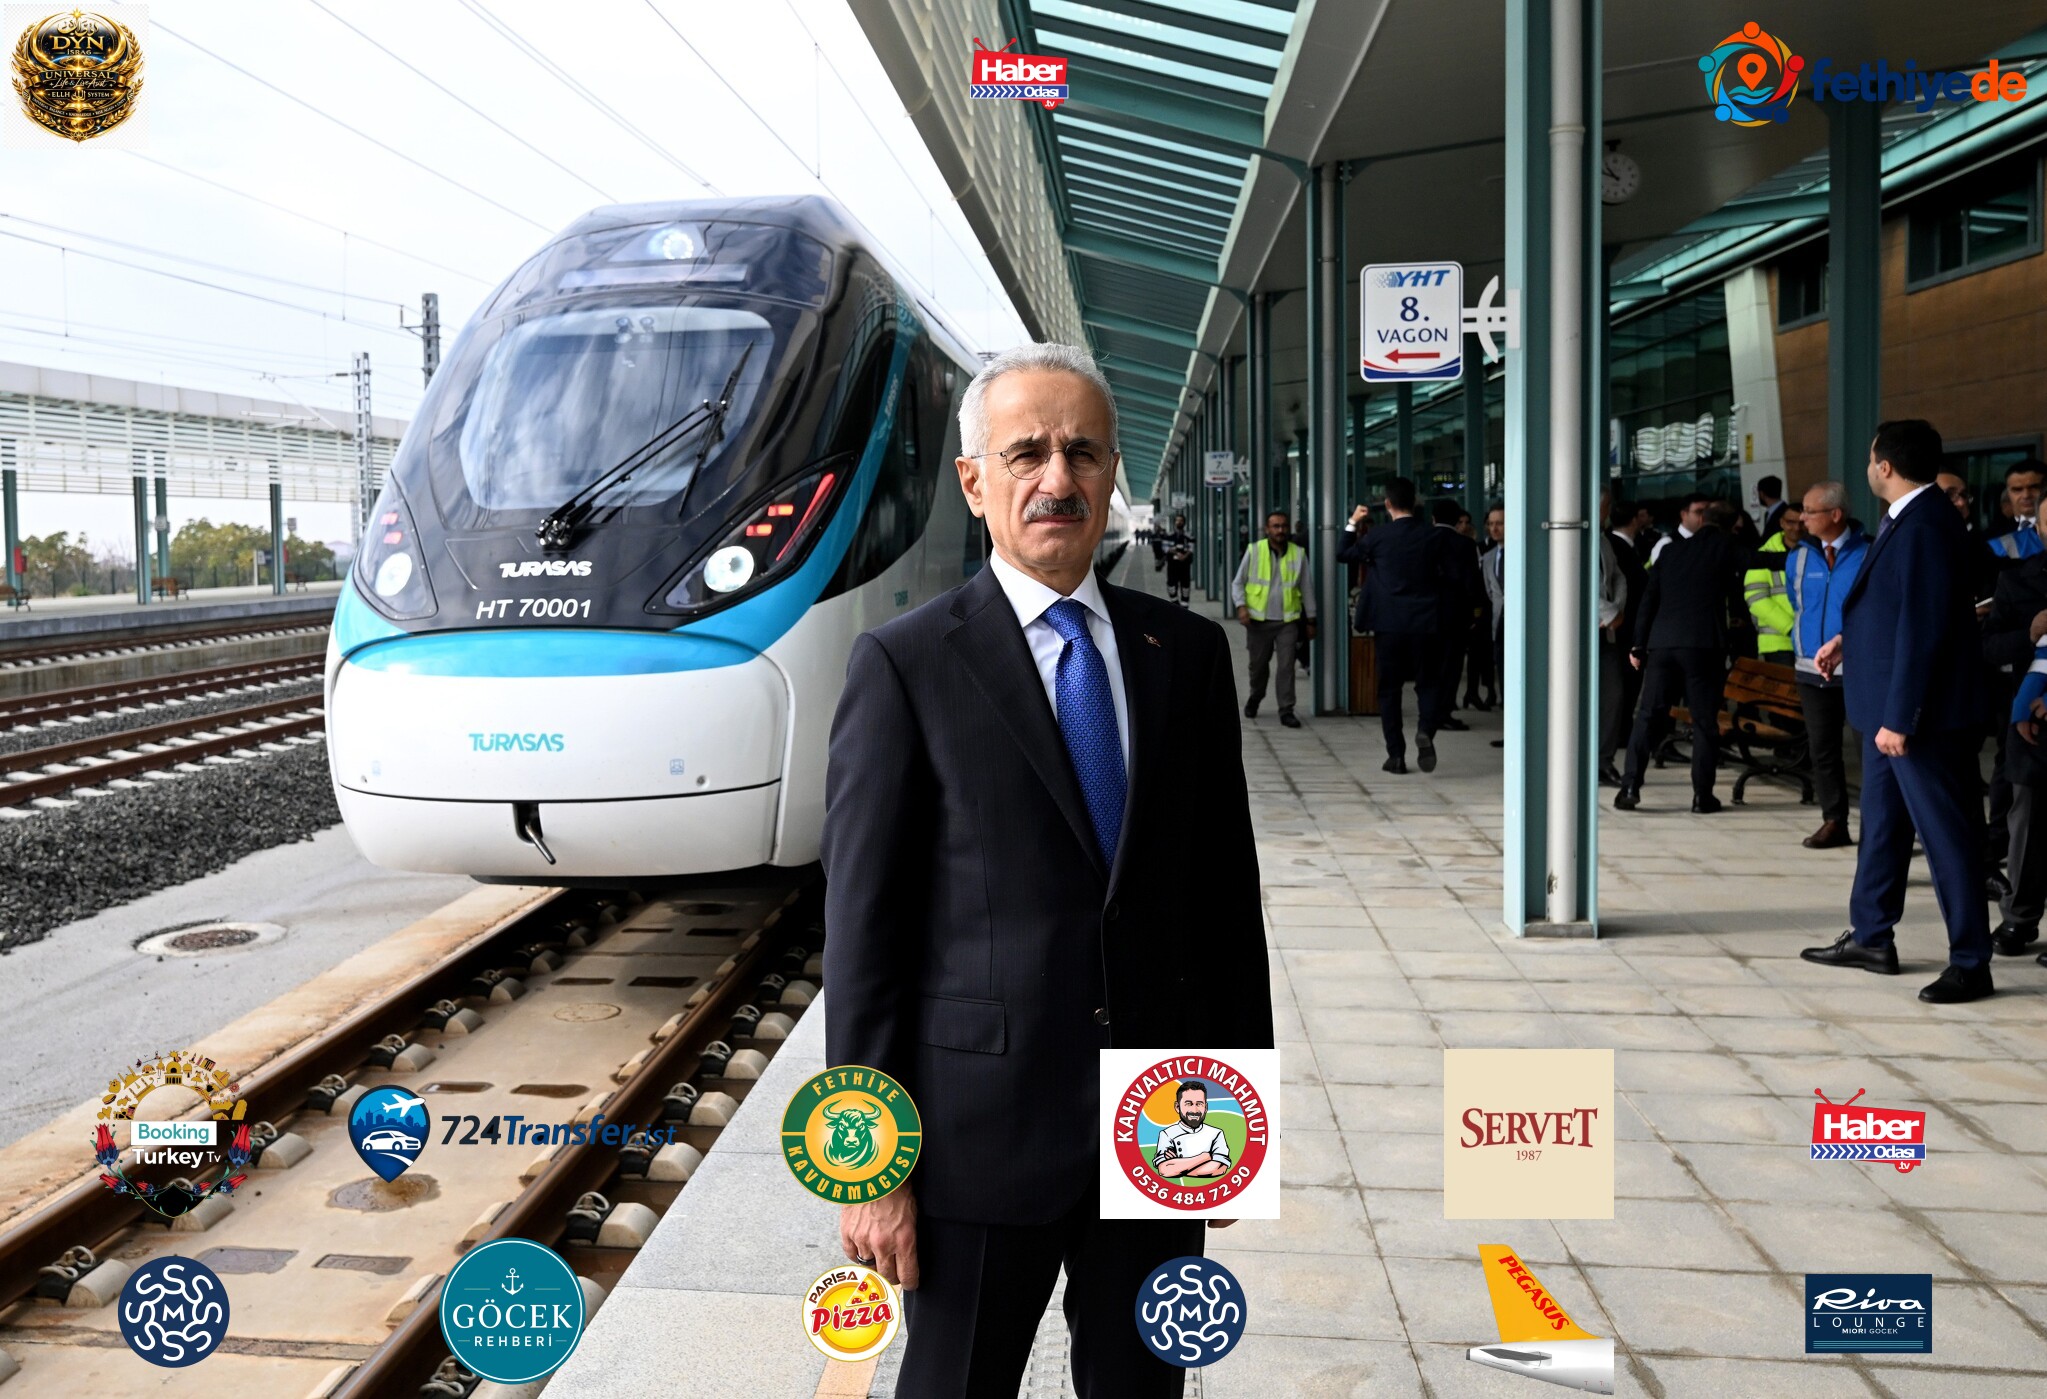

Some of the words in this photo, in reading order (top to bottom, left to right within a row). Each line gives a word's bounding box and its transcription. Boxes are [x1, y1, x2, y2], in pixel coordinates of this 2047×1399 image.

[1395, 269, 1451, 288] YHT
[1400, 296, 1430, 322] 8.
[1376, 328, 1448, 343] VAGON
[476, 599, 514, 620] HT
[518, 598, 592, 619] 70001
